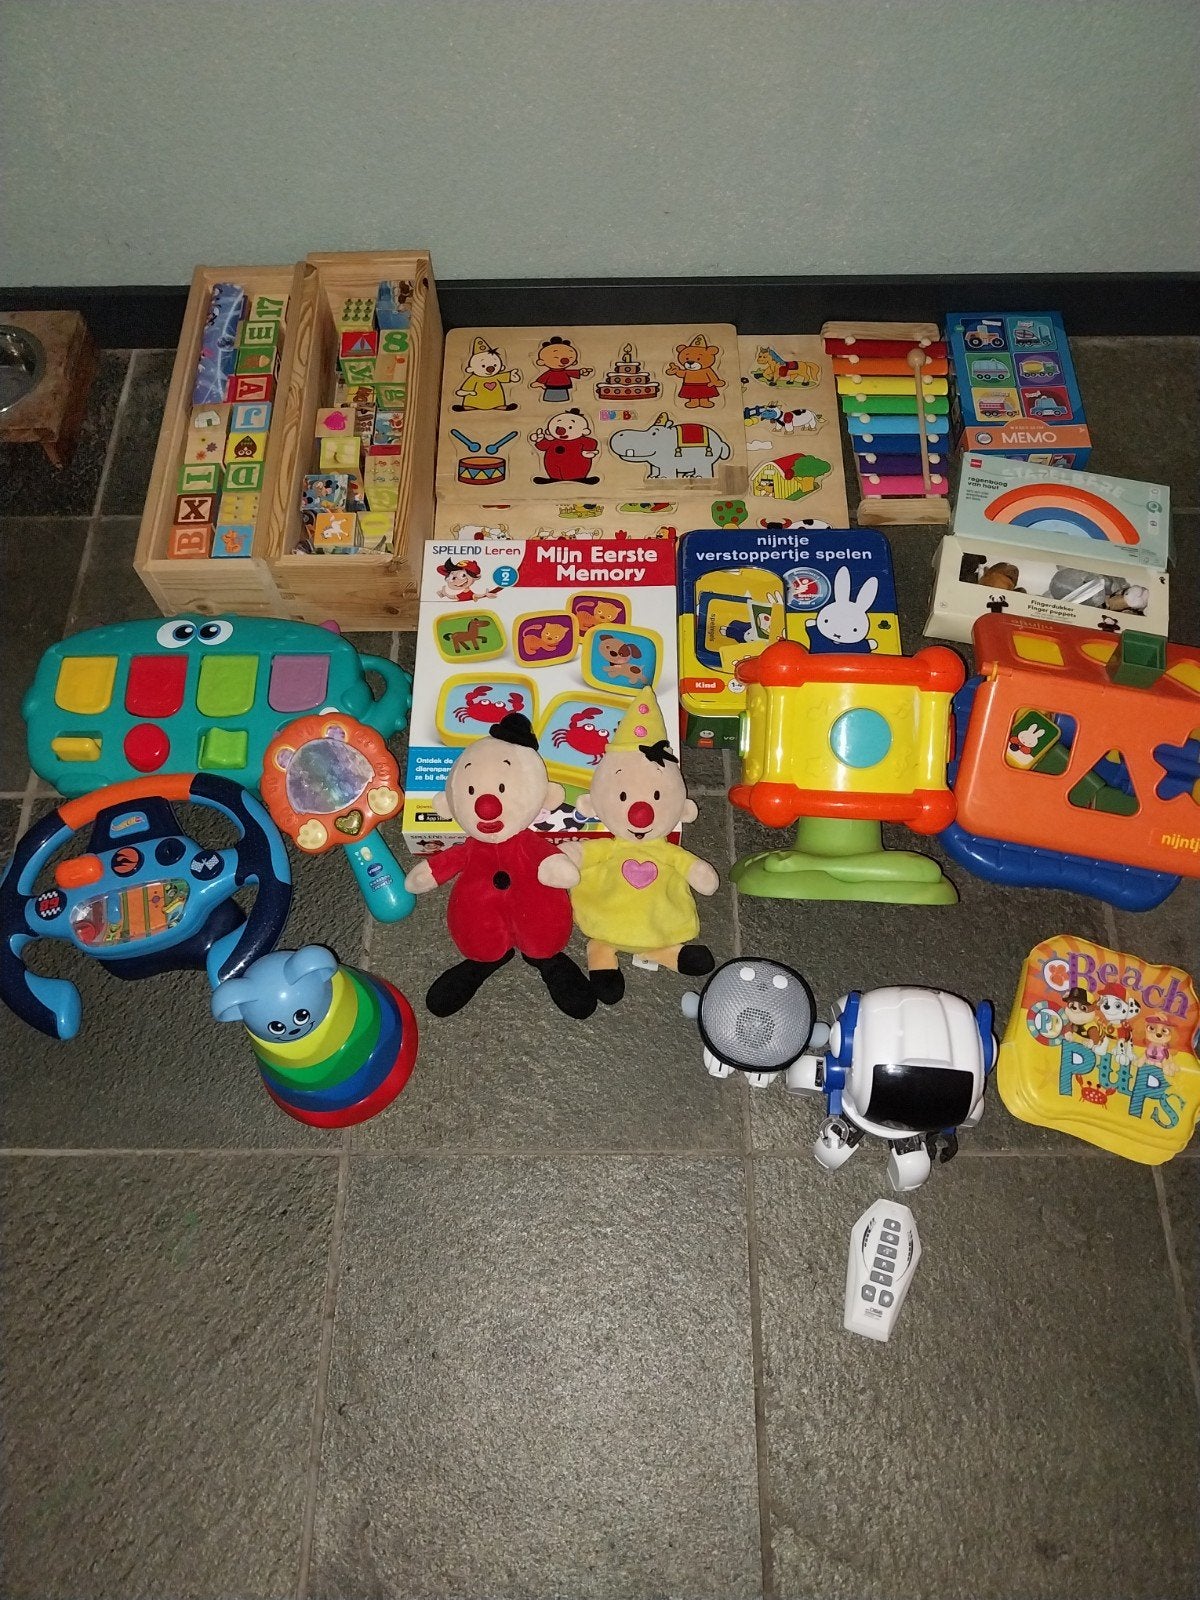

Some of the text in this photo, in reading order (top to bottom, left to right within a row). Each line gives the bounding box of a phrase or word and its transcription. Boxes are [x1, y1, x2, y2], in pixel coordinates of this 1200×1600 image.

[382, 331, 410, 353] 8
[238, 381, 264, 398] A
[1002, 432, 1057, 444] MEMO
[231, 466, 257, 486] D
[181, 499, 209, 520] X
[176, 532, 205, 552] B
[432, 545, 521, 556] SPELEND Leren
[756, 535, 810, 549] nijntje
[536, 547, 659, 564] Mijn Eerste
[696, 548, 873, 563] verstoppertje spelen
[501, 571, 510, 582] 2
[556, 565, 646, 583] Memory
[1027, 604, 1050, 615] Finger
[1161, 833, 1200, 853] nijntj
[1067, 950, 1192, 1019] Beach
